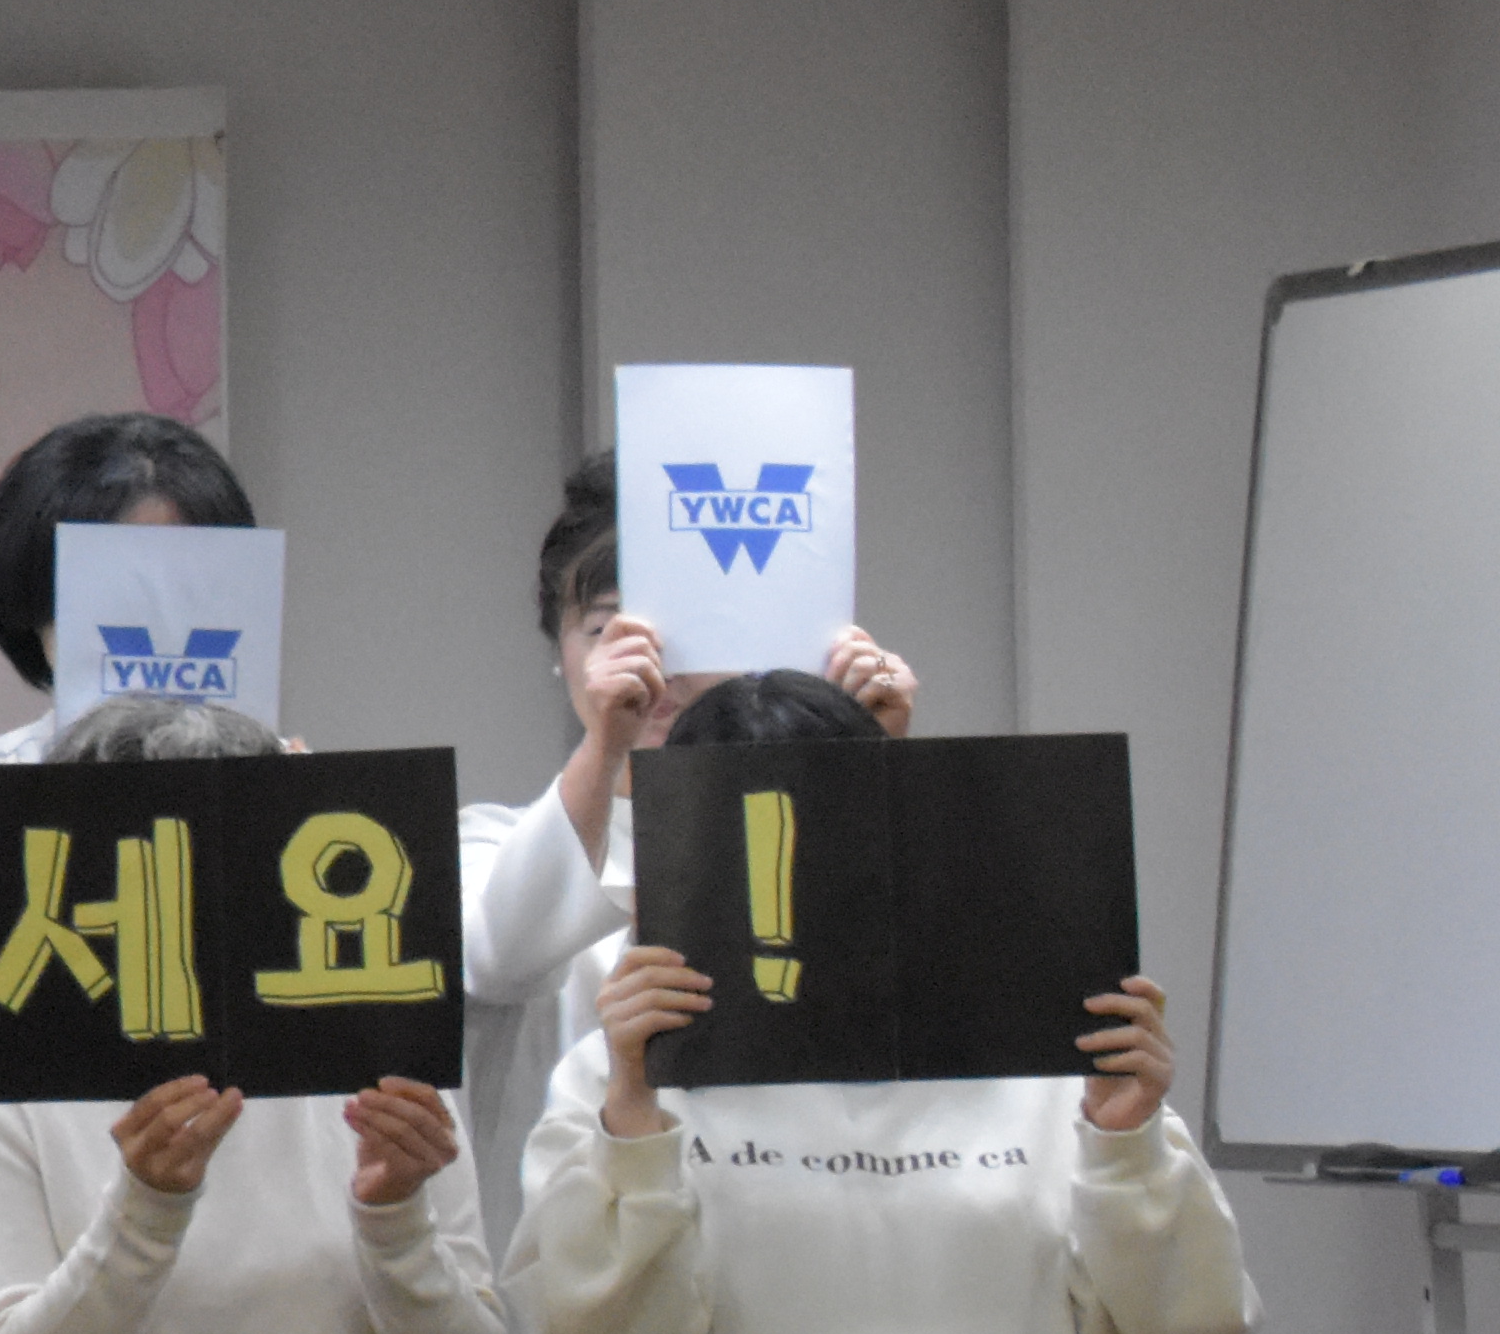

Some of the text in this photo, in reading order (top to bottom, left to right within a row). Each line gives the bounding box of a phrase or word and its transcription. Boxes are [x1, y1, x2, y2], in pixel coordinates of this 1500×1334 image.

[680, 496, 802, 525] YWCA
[112, 661, 227, 690] YWCA
[731, 1140, 784, 1167] de
[801, 1147, 960, 1176] comme
